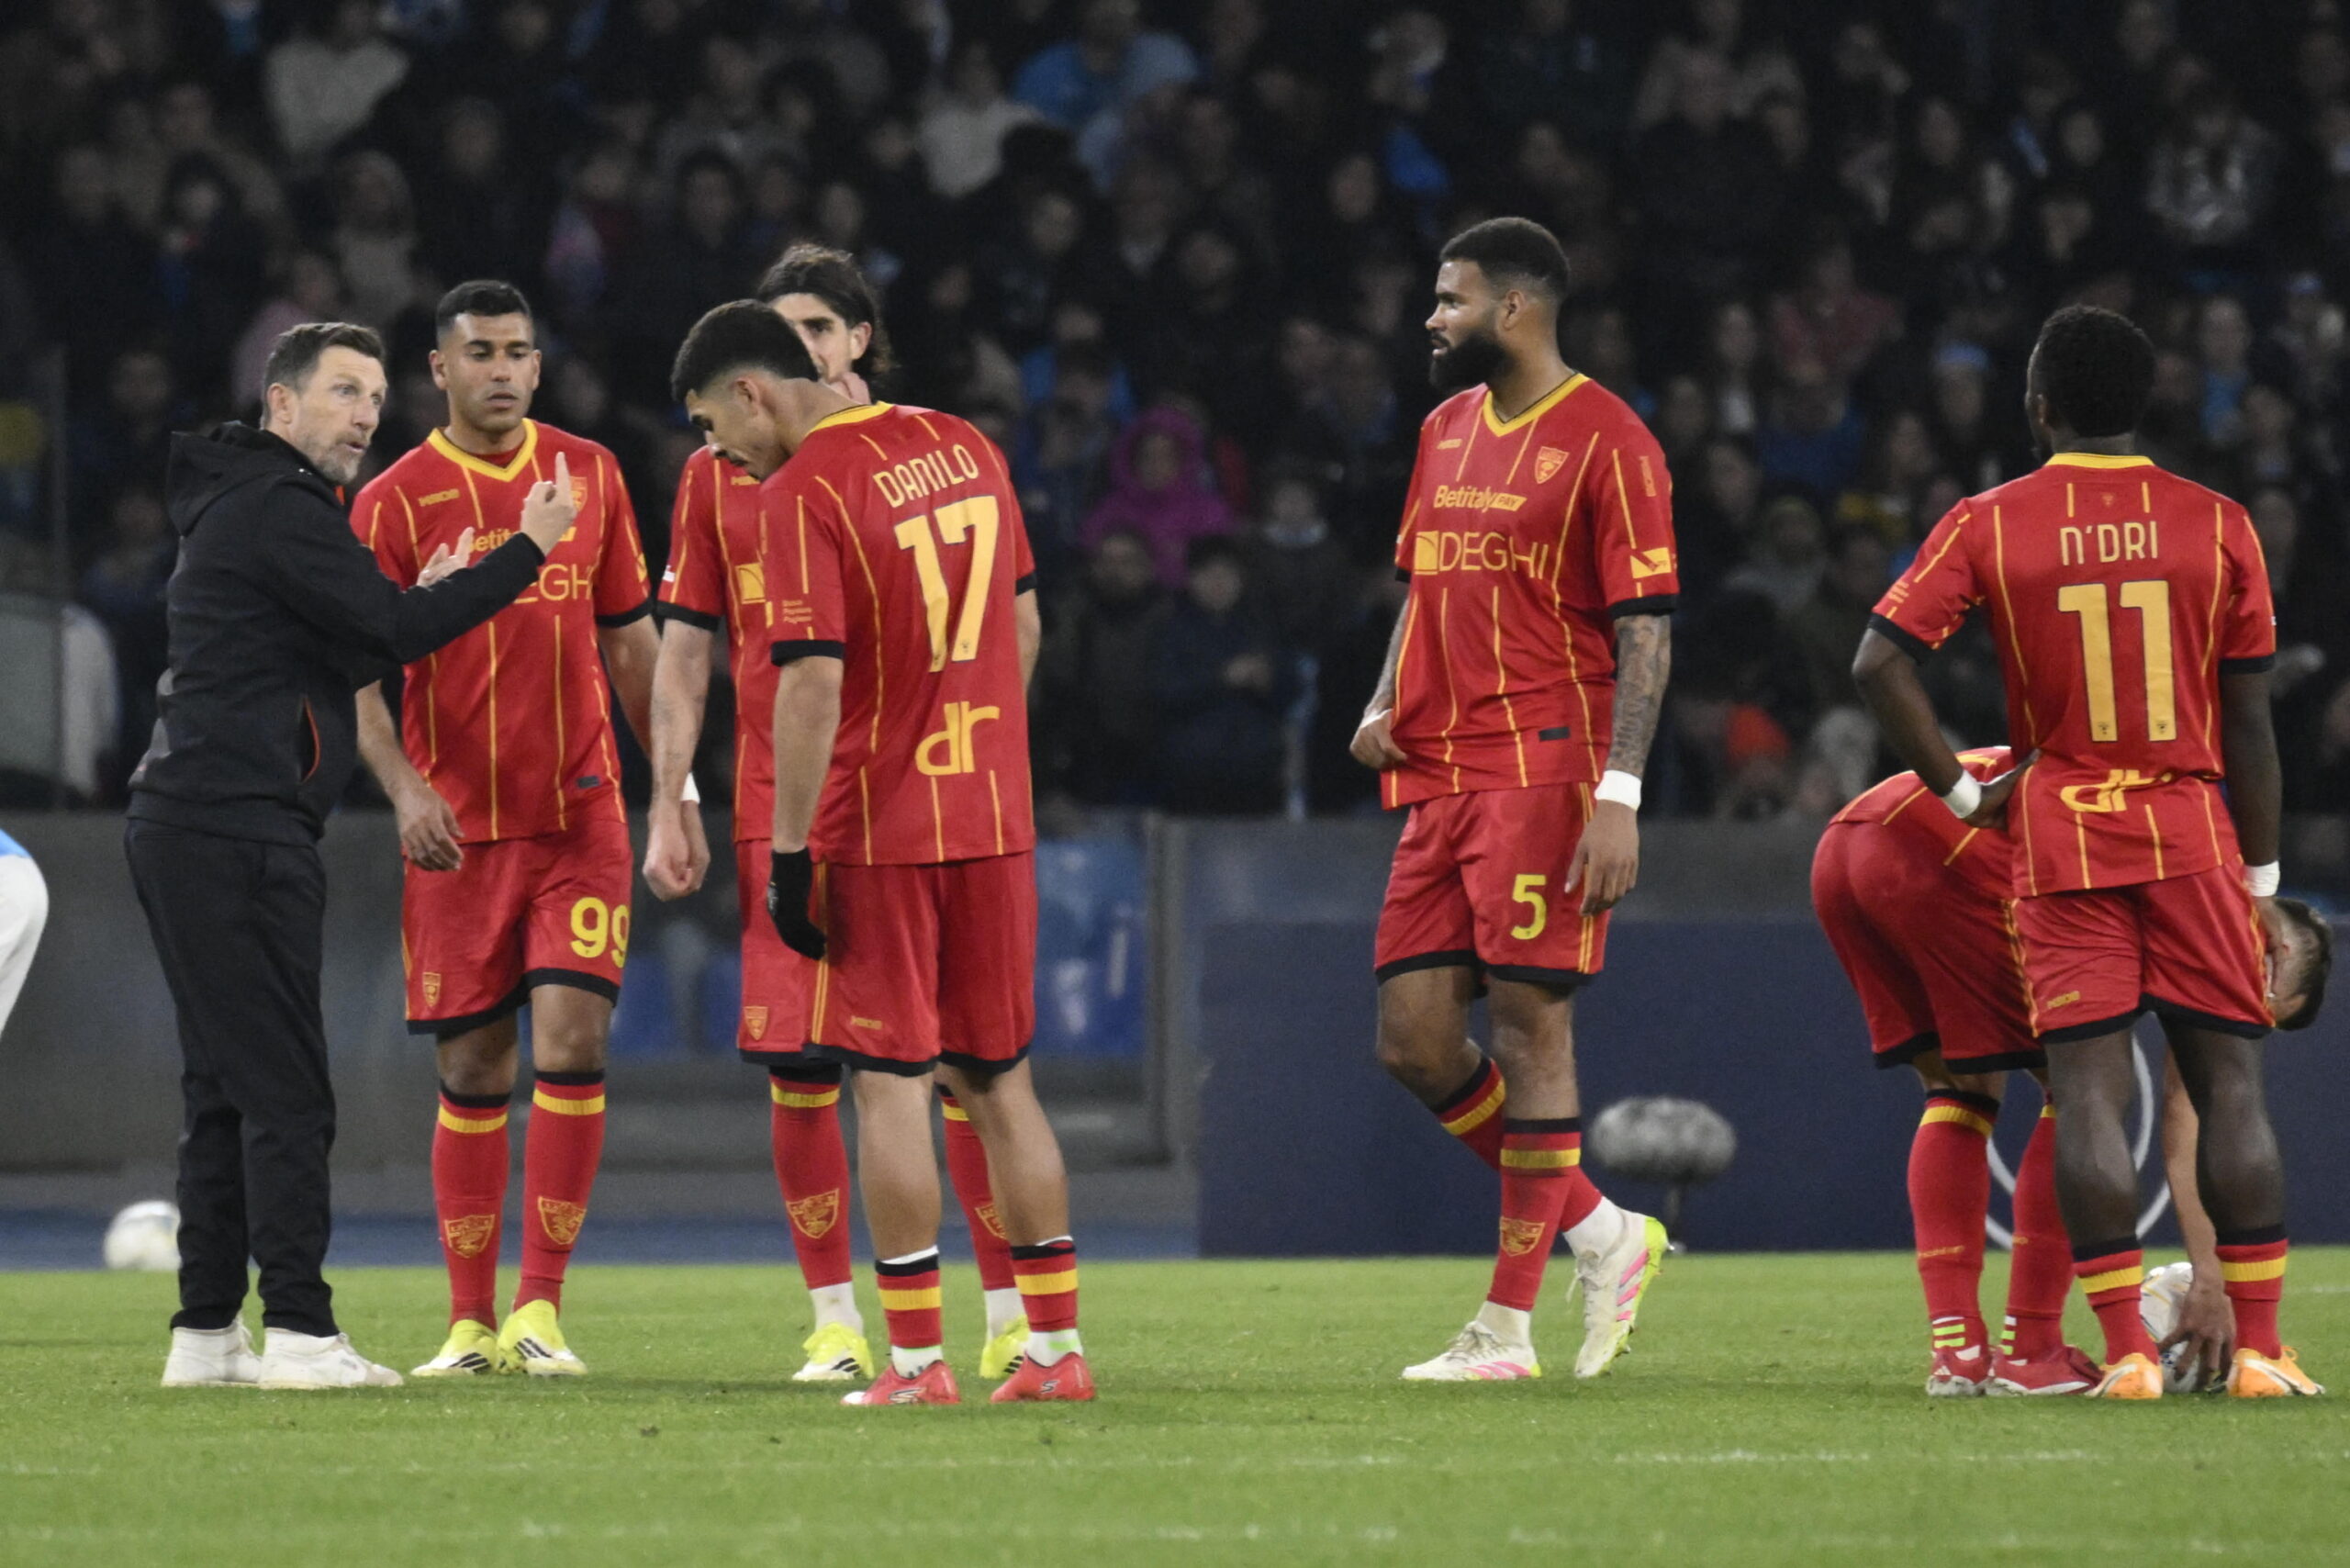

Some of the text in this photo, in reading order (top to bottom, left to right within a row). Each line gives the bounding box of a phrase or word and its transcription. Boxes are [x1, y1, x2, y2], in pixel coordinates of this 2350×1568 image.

[873, 444, 979, 508] DANILO
[894, 495, 999, 672] 17
[1438, 532, 1549, 579] DEGHI
[2057, 580, 2177, 742] 11
[570, 897, 630, 969] 99
[1512, 874, 1547, 939] 5
